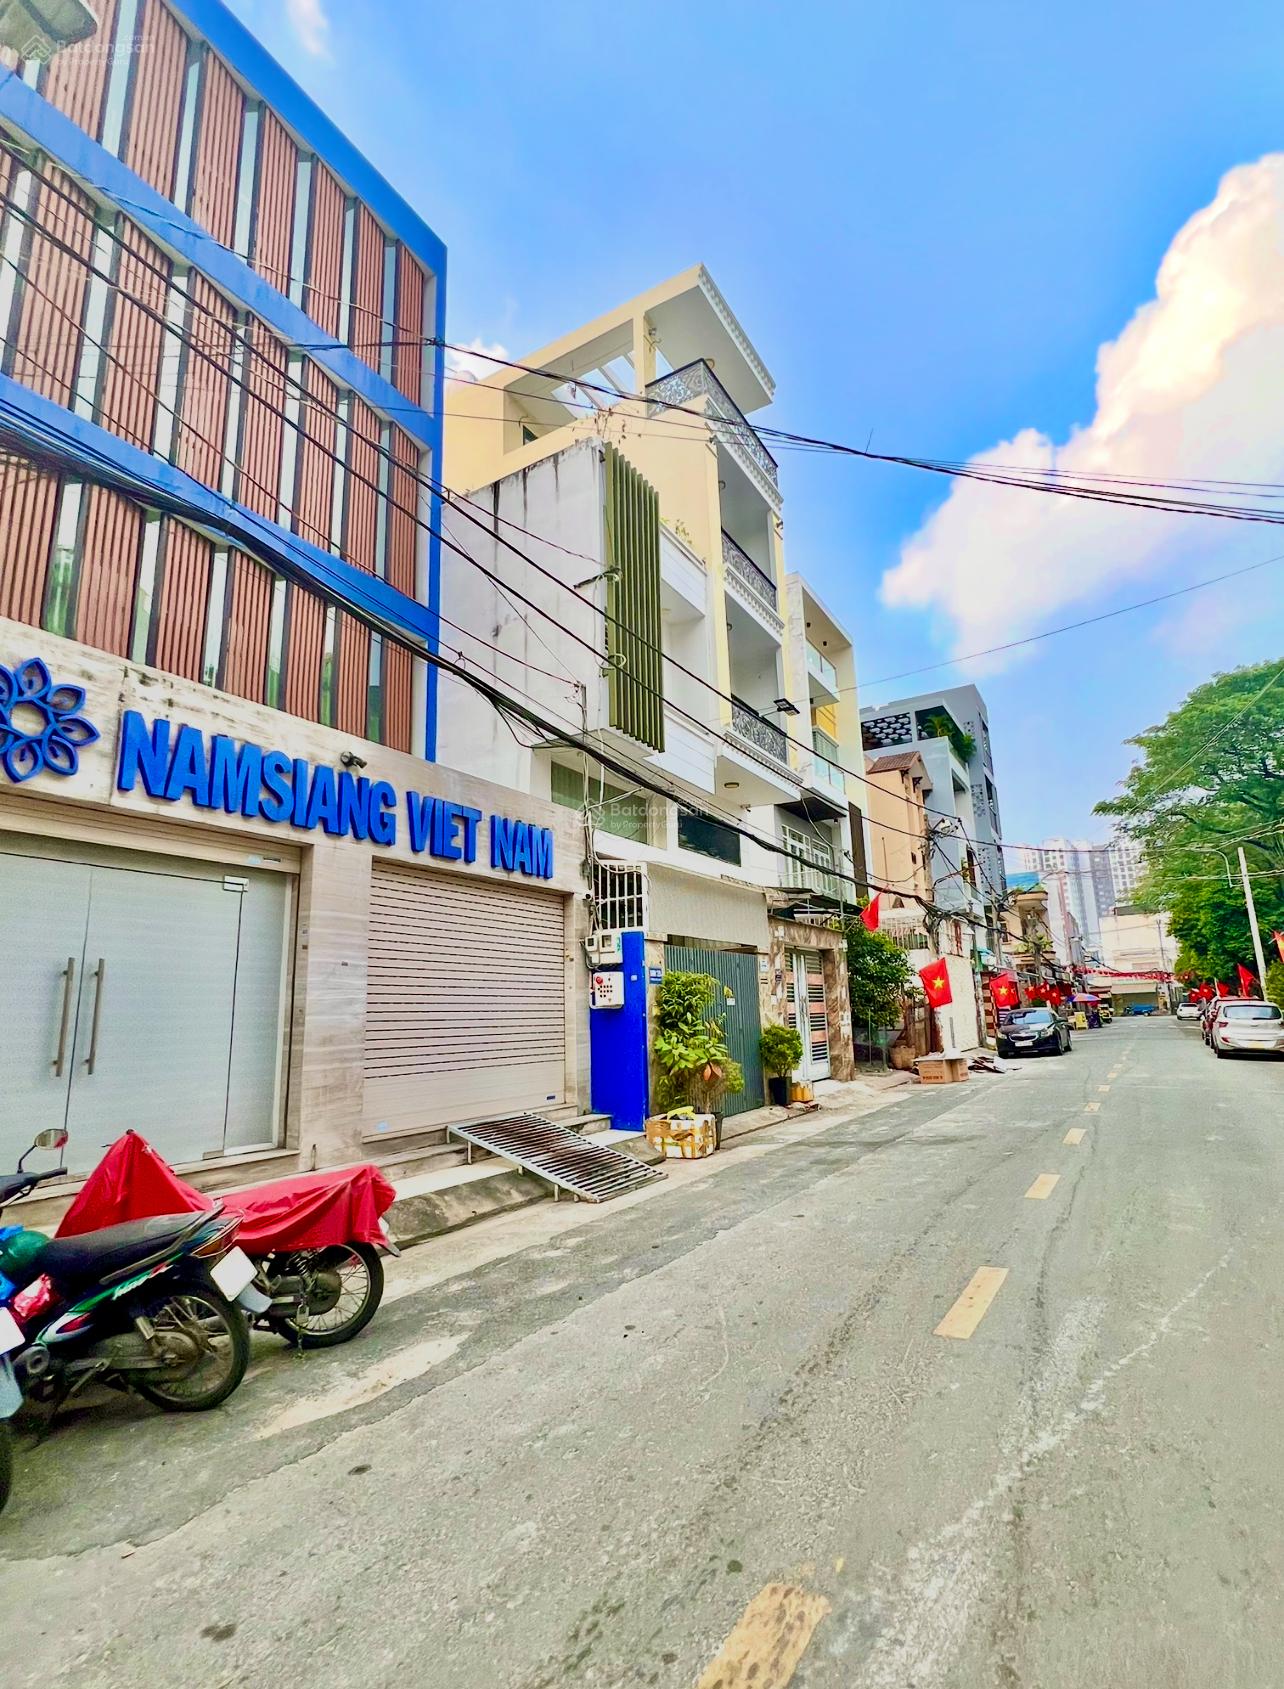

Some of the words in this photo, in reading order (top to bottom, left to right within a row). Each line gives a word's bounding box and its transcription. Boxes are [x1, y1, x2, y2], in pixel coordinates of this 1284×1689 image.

[117, 710, 397, 846] NAMSIANG
[406, 790, 482, 863] VIET
[490, 814, 554, 879] NAM
